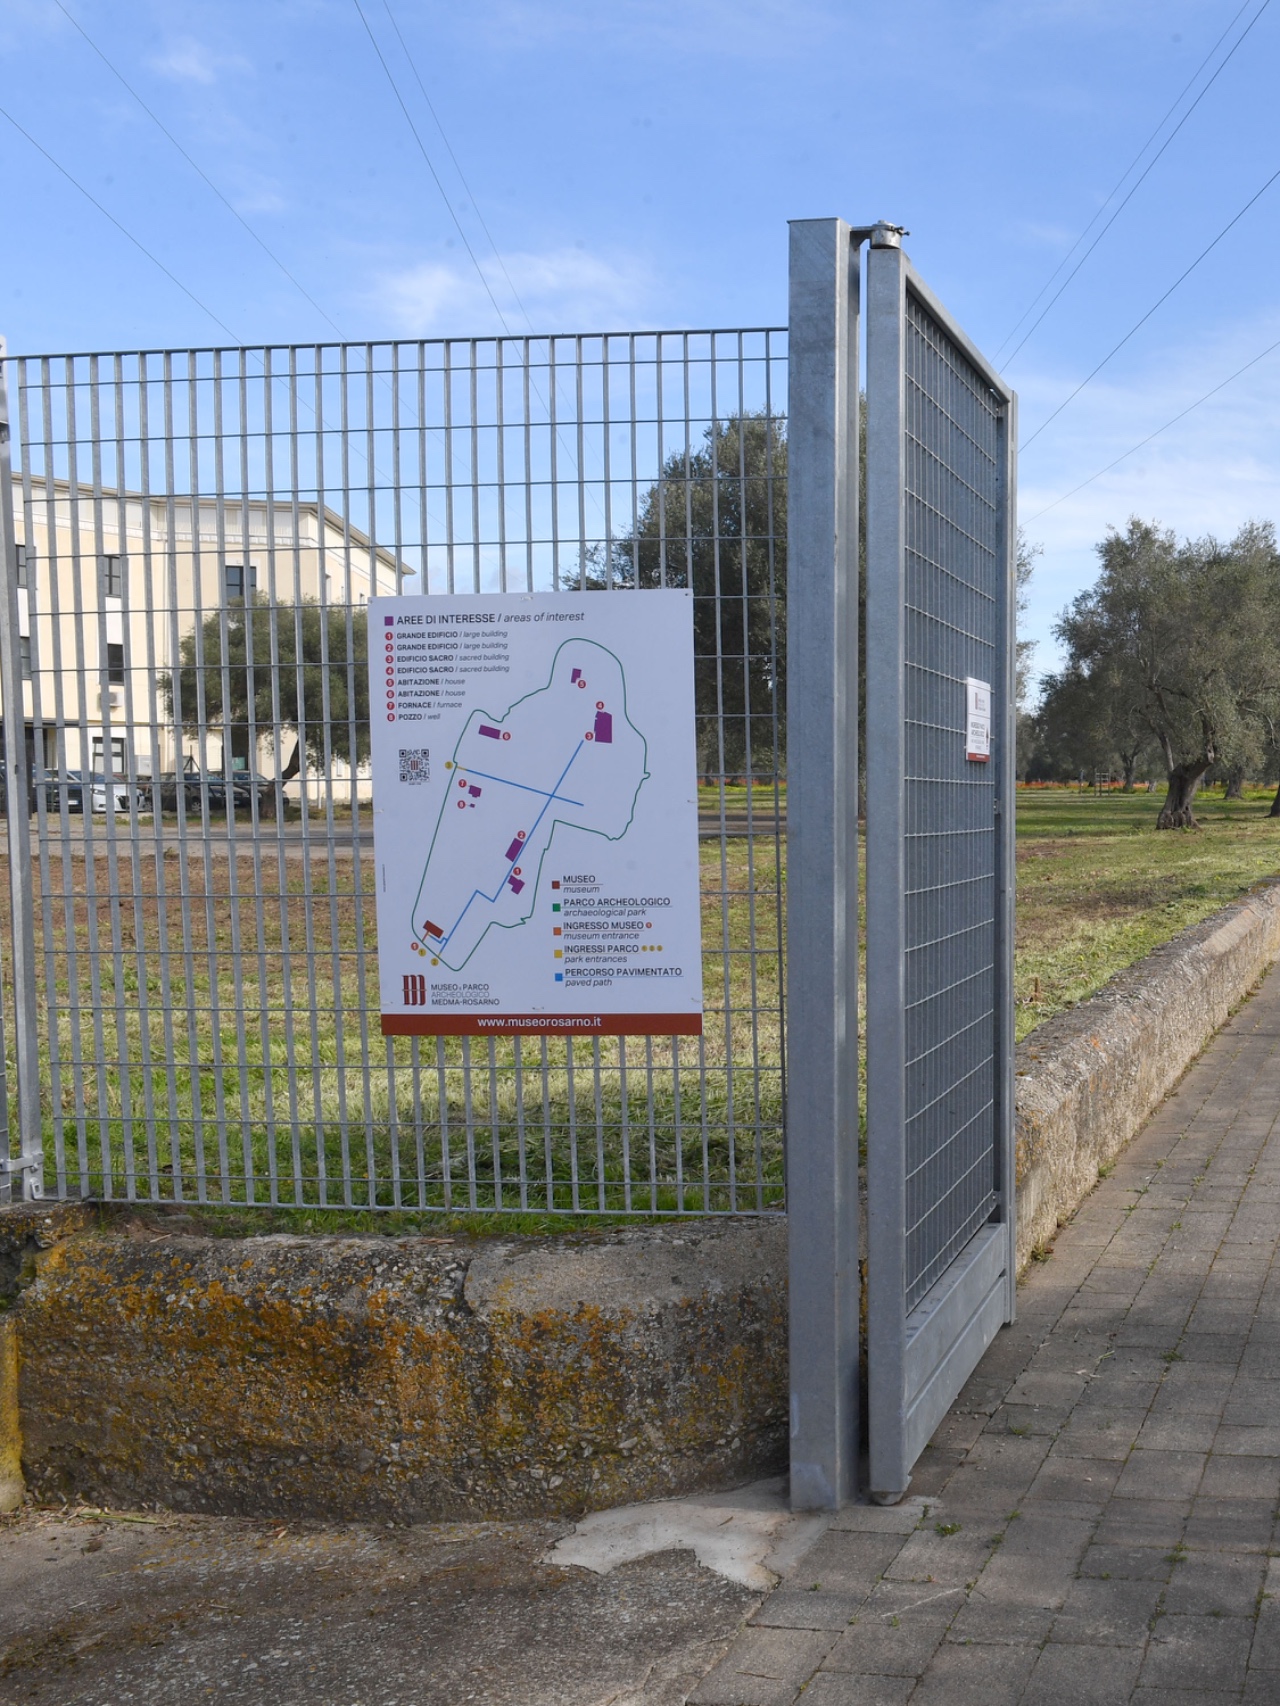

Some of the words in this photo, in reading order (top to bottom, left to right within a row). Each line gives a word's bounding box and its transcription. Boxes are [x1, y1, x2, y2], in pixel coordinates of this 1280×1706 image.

[397, 615, 423, 624] AREE
[426, 614, 436, 624] DI
[439, 614, 495, 624] INTERESSE
[504, 614, 532, 622] areas
[534, 612, 545, 622] of
[546, 612, 585, 621] interest
[481, 630, 508, 638] building
[563, 875, 596, 883] MUSEO
[597, 898, 671, 906] ARCHEOLOGICO
[564, 909, 626, 918] archaeological
[627, 908, 647, 917] park
[563, 922, 609, 930] INGRESSO
[611, 921, 644, 929] MUSEO
[607, 944, 639, 952] PARCO
[564, 955, 583, 964] park
[565, 968, 614, 976] PERCORSO
[616, 968, 682, 976] PAVIMENTATO
[565, 979, 591, 988] paved
[593, 978, 612, 987] path
[477, 1016, 602, 1027] www.museorosarno.it
